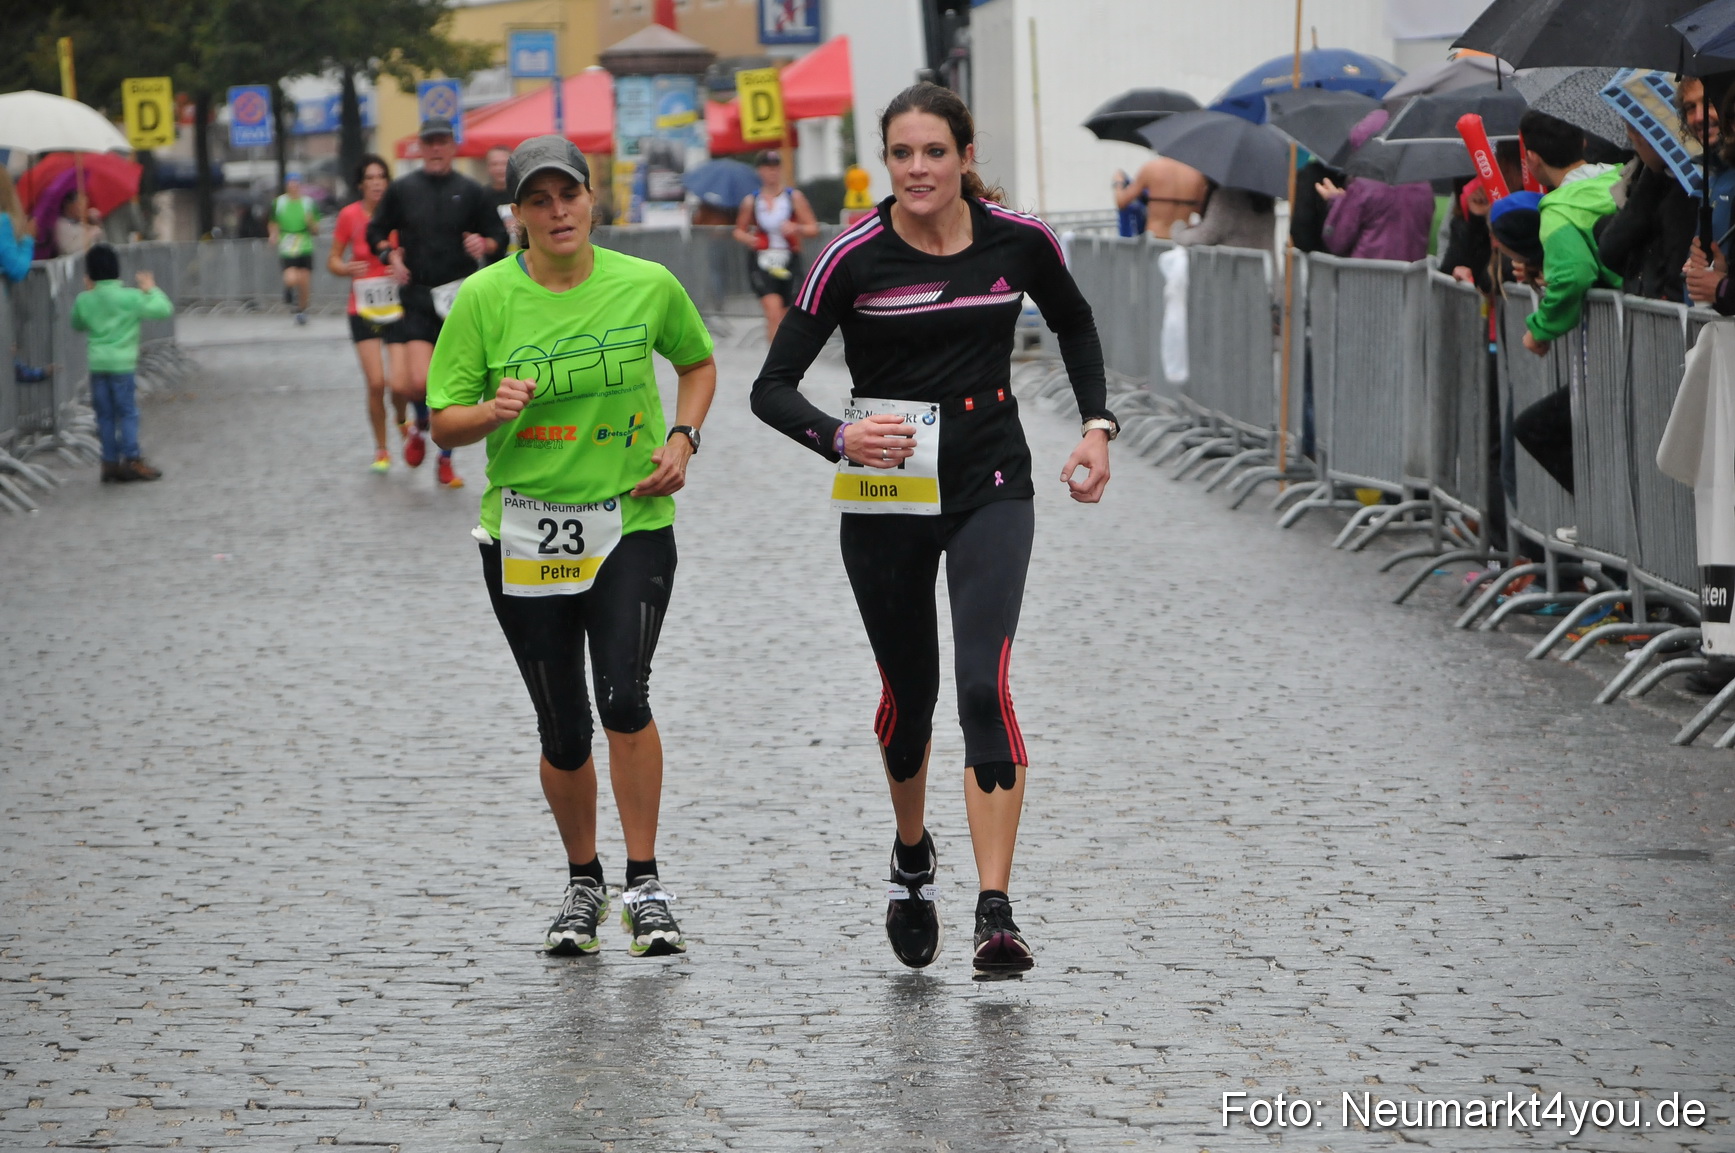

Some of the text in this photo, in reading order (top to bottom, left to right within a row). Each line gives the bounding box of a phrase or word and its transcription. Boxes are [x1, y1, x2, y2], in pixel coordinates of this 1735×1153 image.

[751, 91, 773, 121] D
[138, 101, 159, 131] D
[516, 425, 578, 441] MERZ
[860, 480, 898, 497] Ilona
[504, 497, 599, 513] PARTL Neumarkt
[537, 517, 585, 555] 23
[540, 564, 581, 581] Petra
